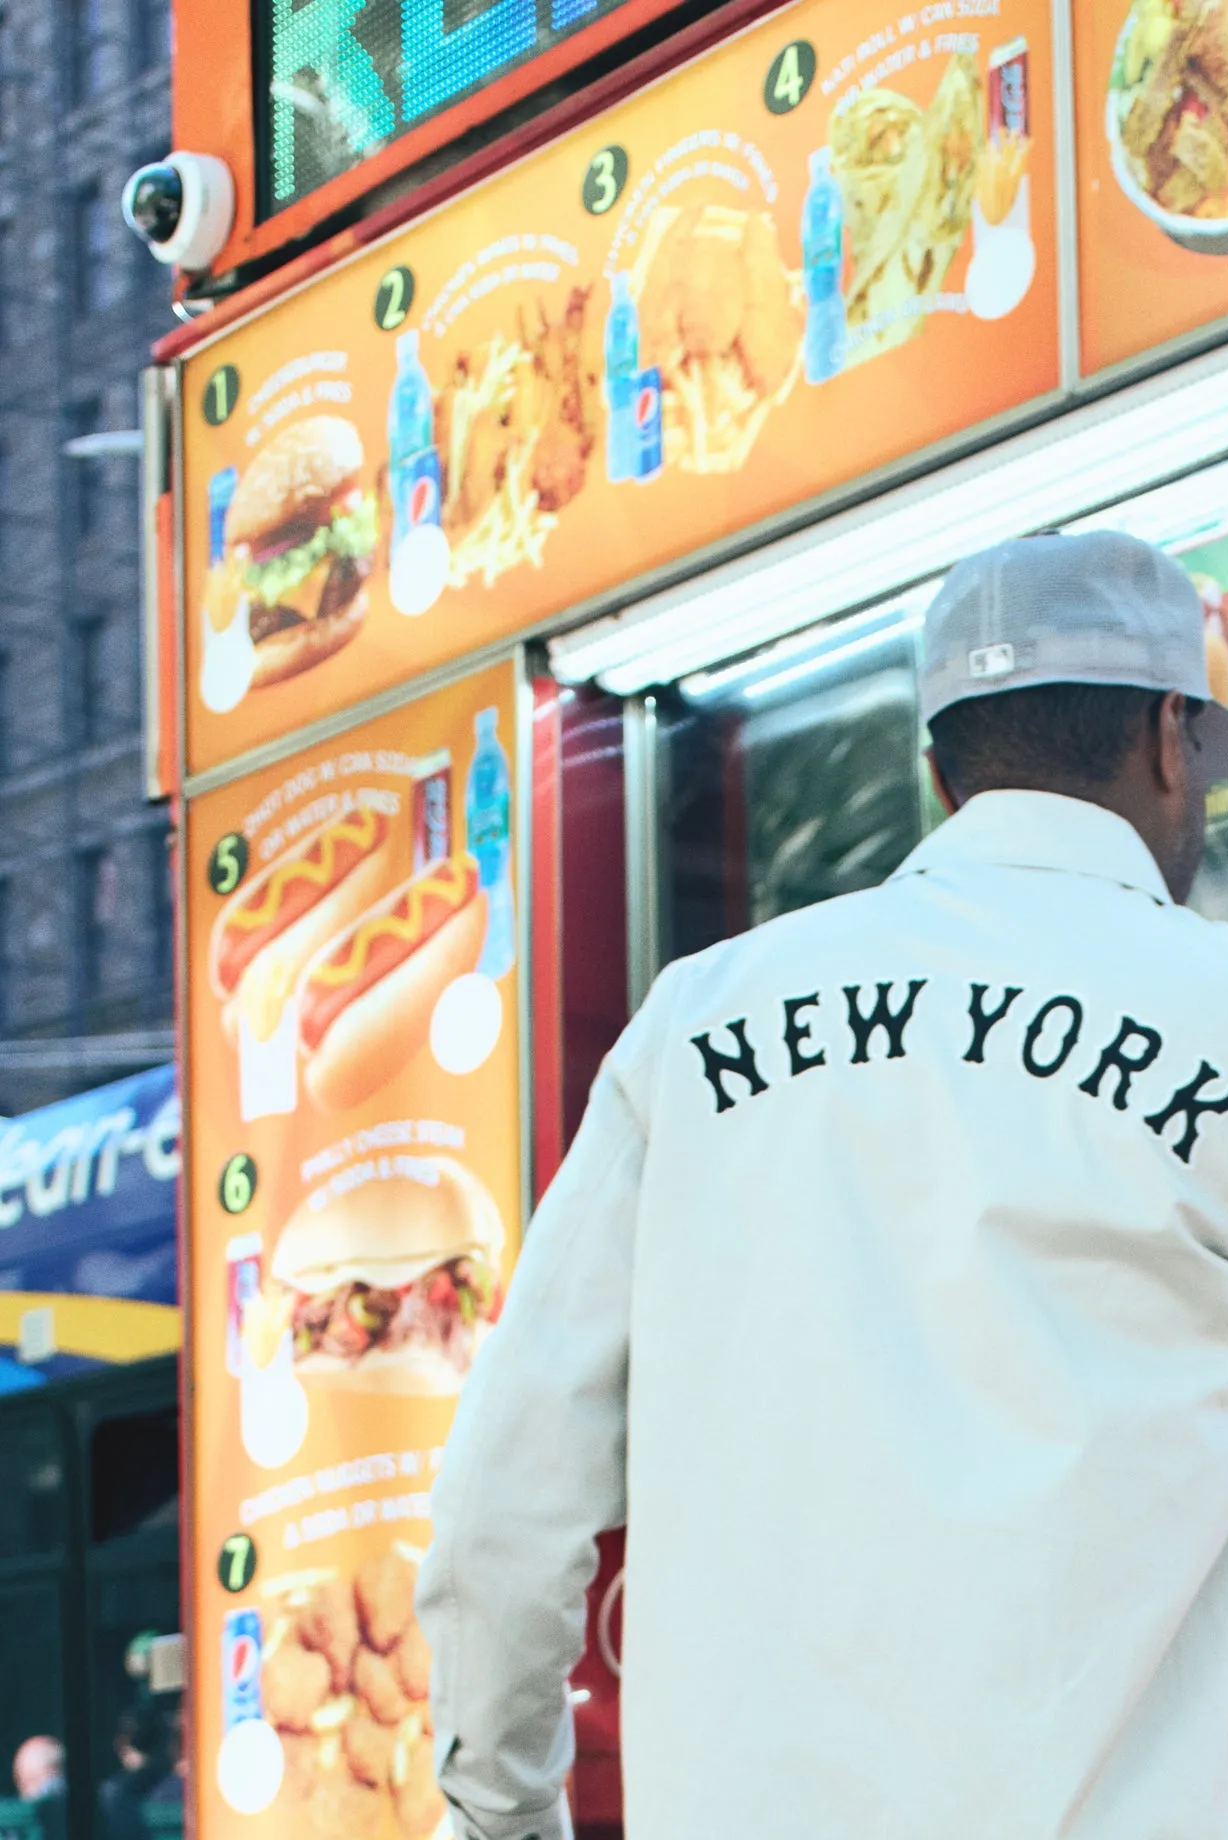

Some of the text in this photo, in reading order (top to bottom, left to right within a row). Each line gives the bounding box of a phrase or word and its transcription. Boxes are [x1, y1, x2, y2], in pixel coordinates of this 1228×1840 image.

[920, 2, 954, 26] CAN
[934, 33, 982, 54] FRIES
[774, 44, 804, 106] 4
[592, 151, 617, 213] 3
[382, 270, 406, 330] 2
[216, 834, 240, 894] 5
[690, 979, 928, 1114] NEW
[224, 1153, 251, 1213] 6
[381, 1492, 431, 1521] WATE
[223, 1535, 251, 1592] 7
